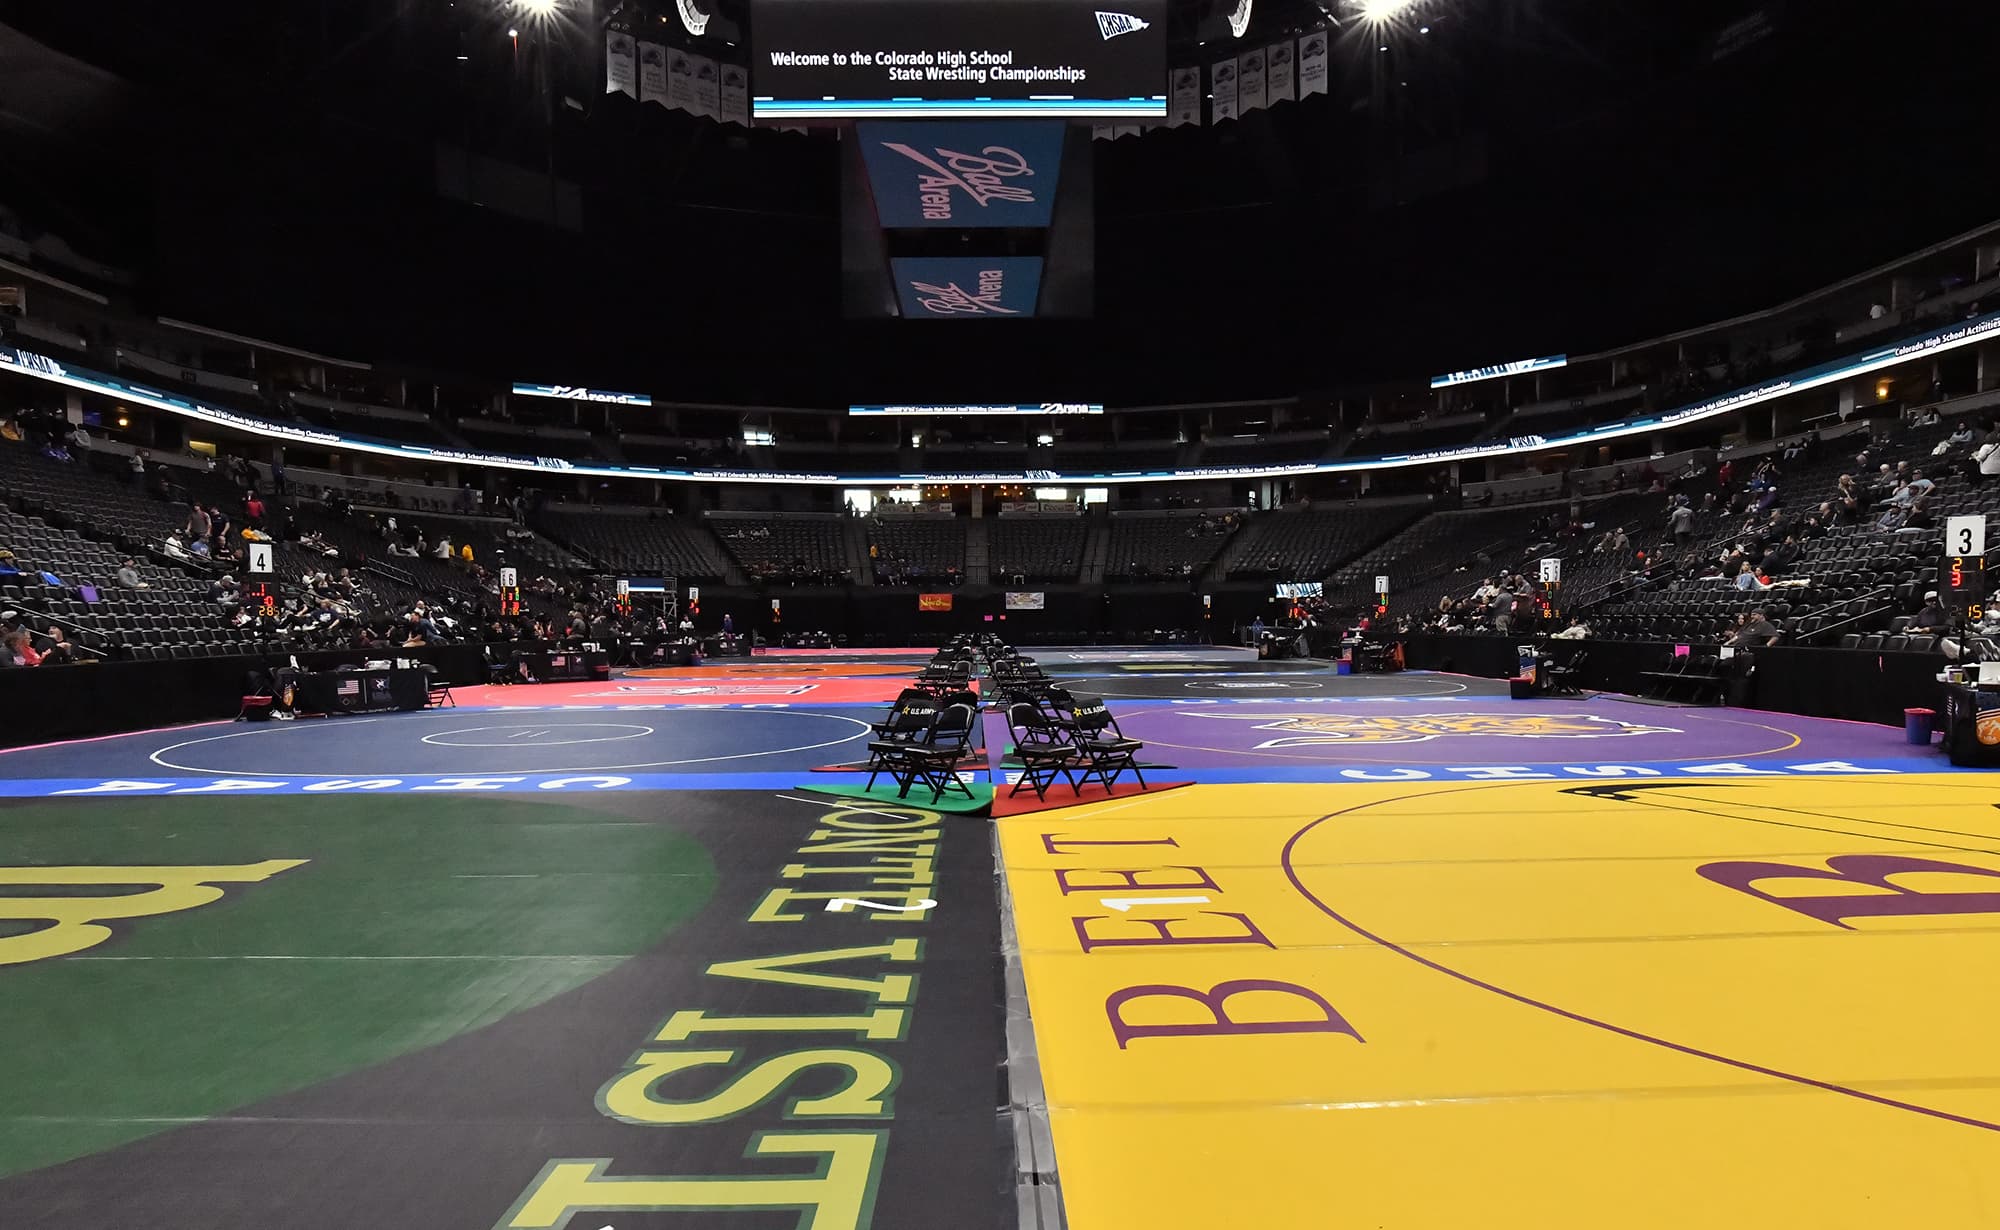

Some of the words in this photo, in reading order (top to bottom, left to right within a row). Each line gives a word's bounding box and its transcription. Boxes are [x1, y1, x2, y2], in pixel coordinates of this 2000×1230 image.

[1098, 13, 1133, 37] CHSAA
[771, 51, 829, 66] Welcome
[832, 52, 847, 65] to
[850, 51, 872, 65] the
[875, 51, 933, 65] Colorado
[937, 51, 966, 67] High
[970, 50, 1012, 65] School
[889, 66, 922, 80] State
[926, 66, 987, 83] Wrestling
[990, 66, 1086, 83] Championships
[917, 174, 955, 220] Arena
[1895, 341, 1924, 356] Colorado
[1925, 336, 1941, 348] High
[1942, 328, 1965, 342] School
[1958, 528, 1972, 554] 3
[257, 553, 266, 571] 4
[1952, 557, 1962, 572] 2
[508, 573, 514, 586] 6
[1544, 566, 1549, 581] 5
[1951, 572, 1961, 586] 3
[1968, 604, 1982, 619] 15
[1040, 832, 1367, 1051] BEET
